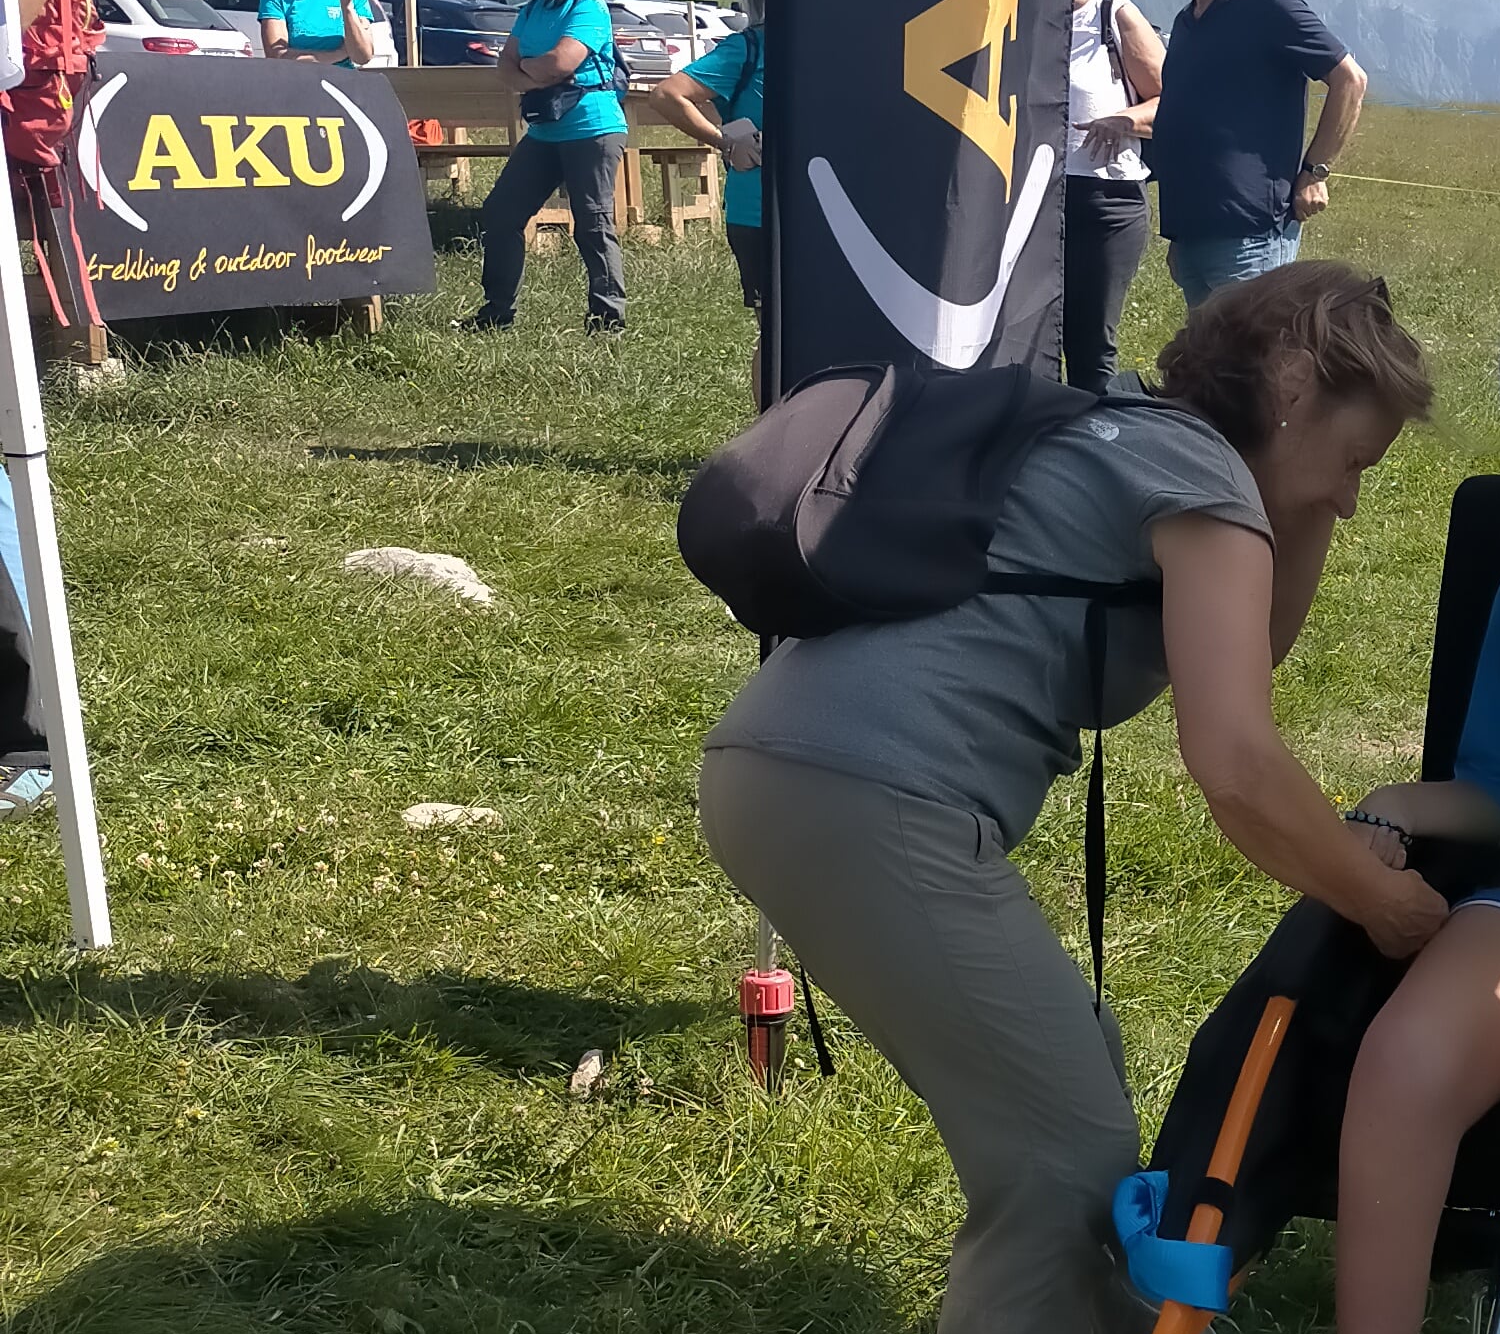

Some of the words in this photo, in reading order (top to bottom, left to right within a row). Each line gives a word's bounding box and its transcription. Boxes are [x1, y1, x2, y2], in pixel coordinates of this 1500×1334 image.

[127, 114, 346, 191] AKU
[86, 248, 181, 292] trekking
[189, 247, 208, 282] &
[214, 243, 297, 274] outdoor
[305, 235, 392, 281] footwear
